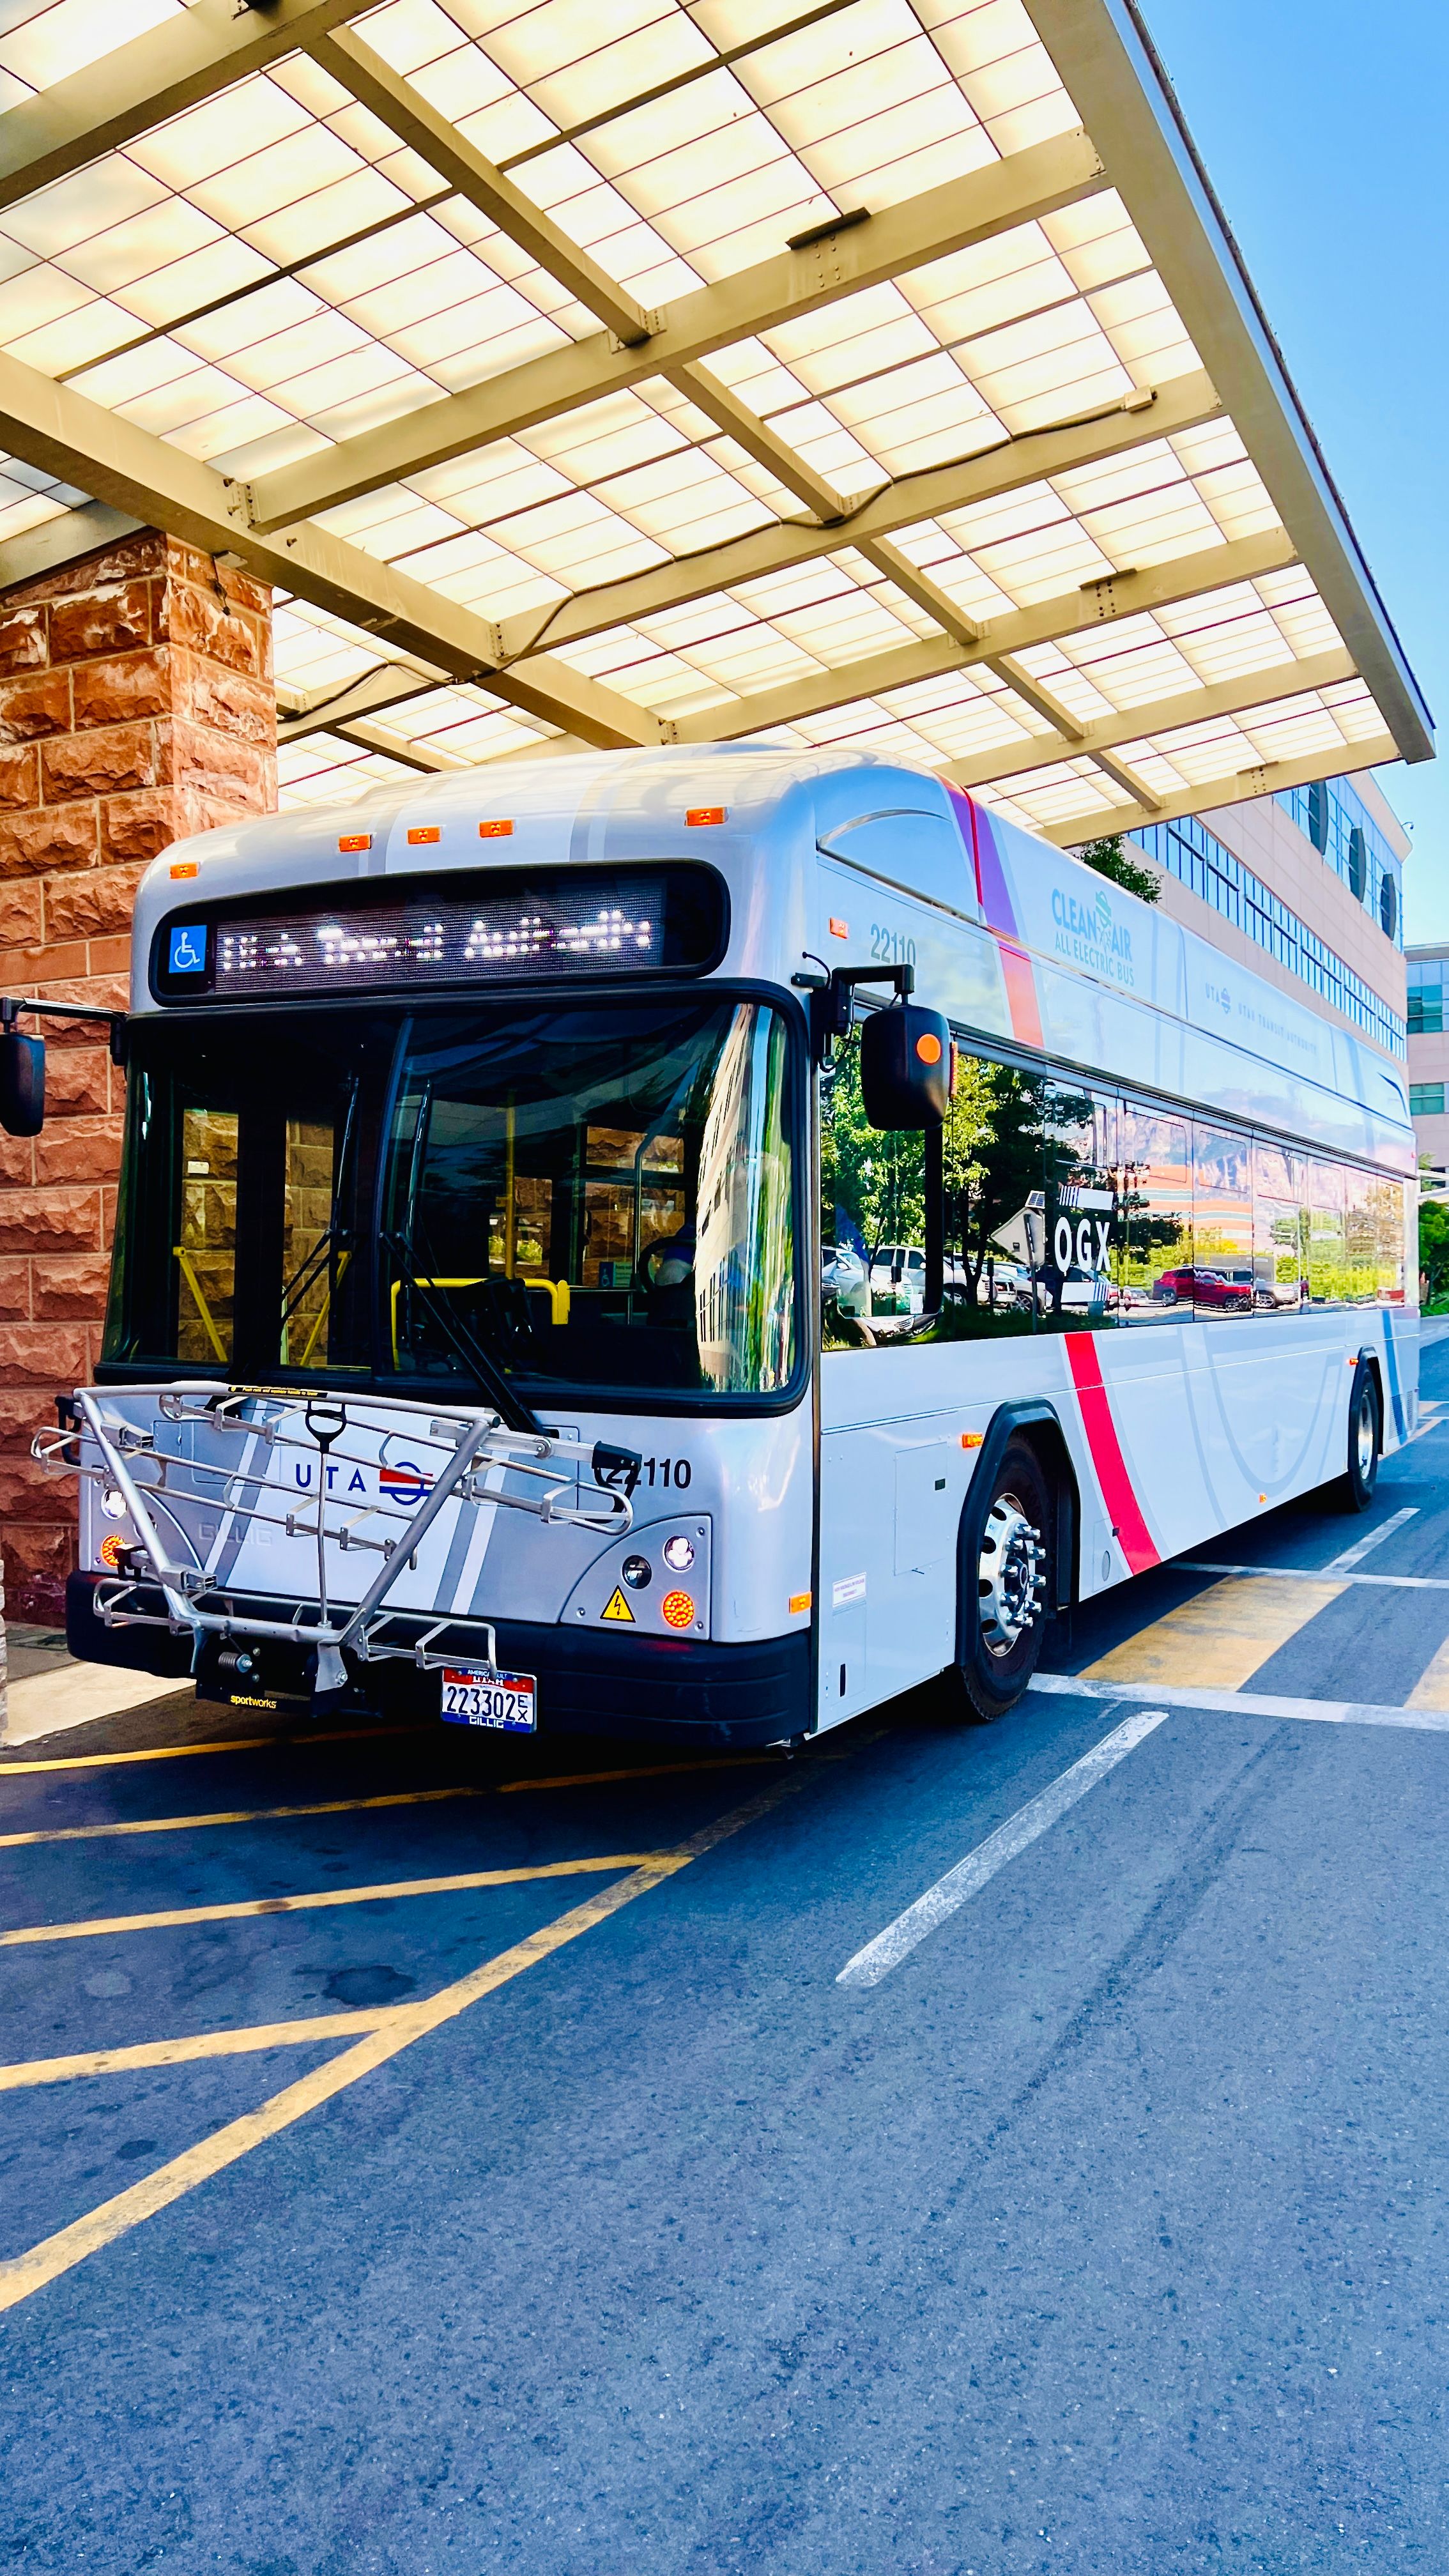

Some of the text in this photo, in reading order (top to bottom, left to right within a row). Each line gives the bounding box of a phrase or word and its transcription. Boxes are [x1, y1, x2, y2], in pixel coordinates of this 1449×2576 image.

[1052, 888, 1133, 962] CLEAN AIR
[871, 924, 916, 967] 22110
[1055, 931, 1134, 987] ALL ELECTRIC BUS
[1206, 982, 1220, 1004] UTA
[1055, 1216, 1112, 1273] OGX
[296, 1463, 367, 1492] UTA
[231, 1695, 277, 1709] sportworks
[447, 1685, 516, 1721] 223302
[469, 1715, 504, 1729] GILLIG
